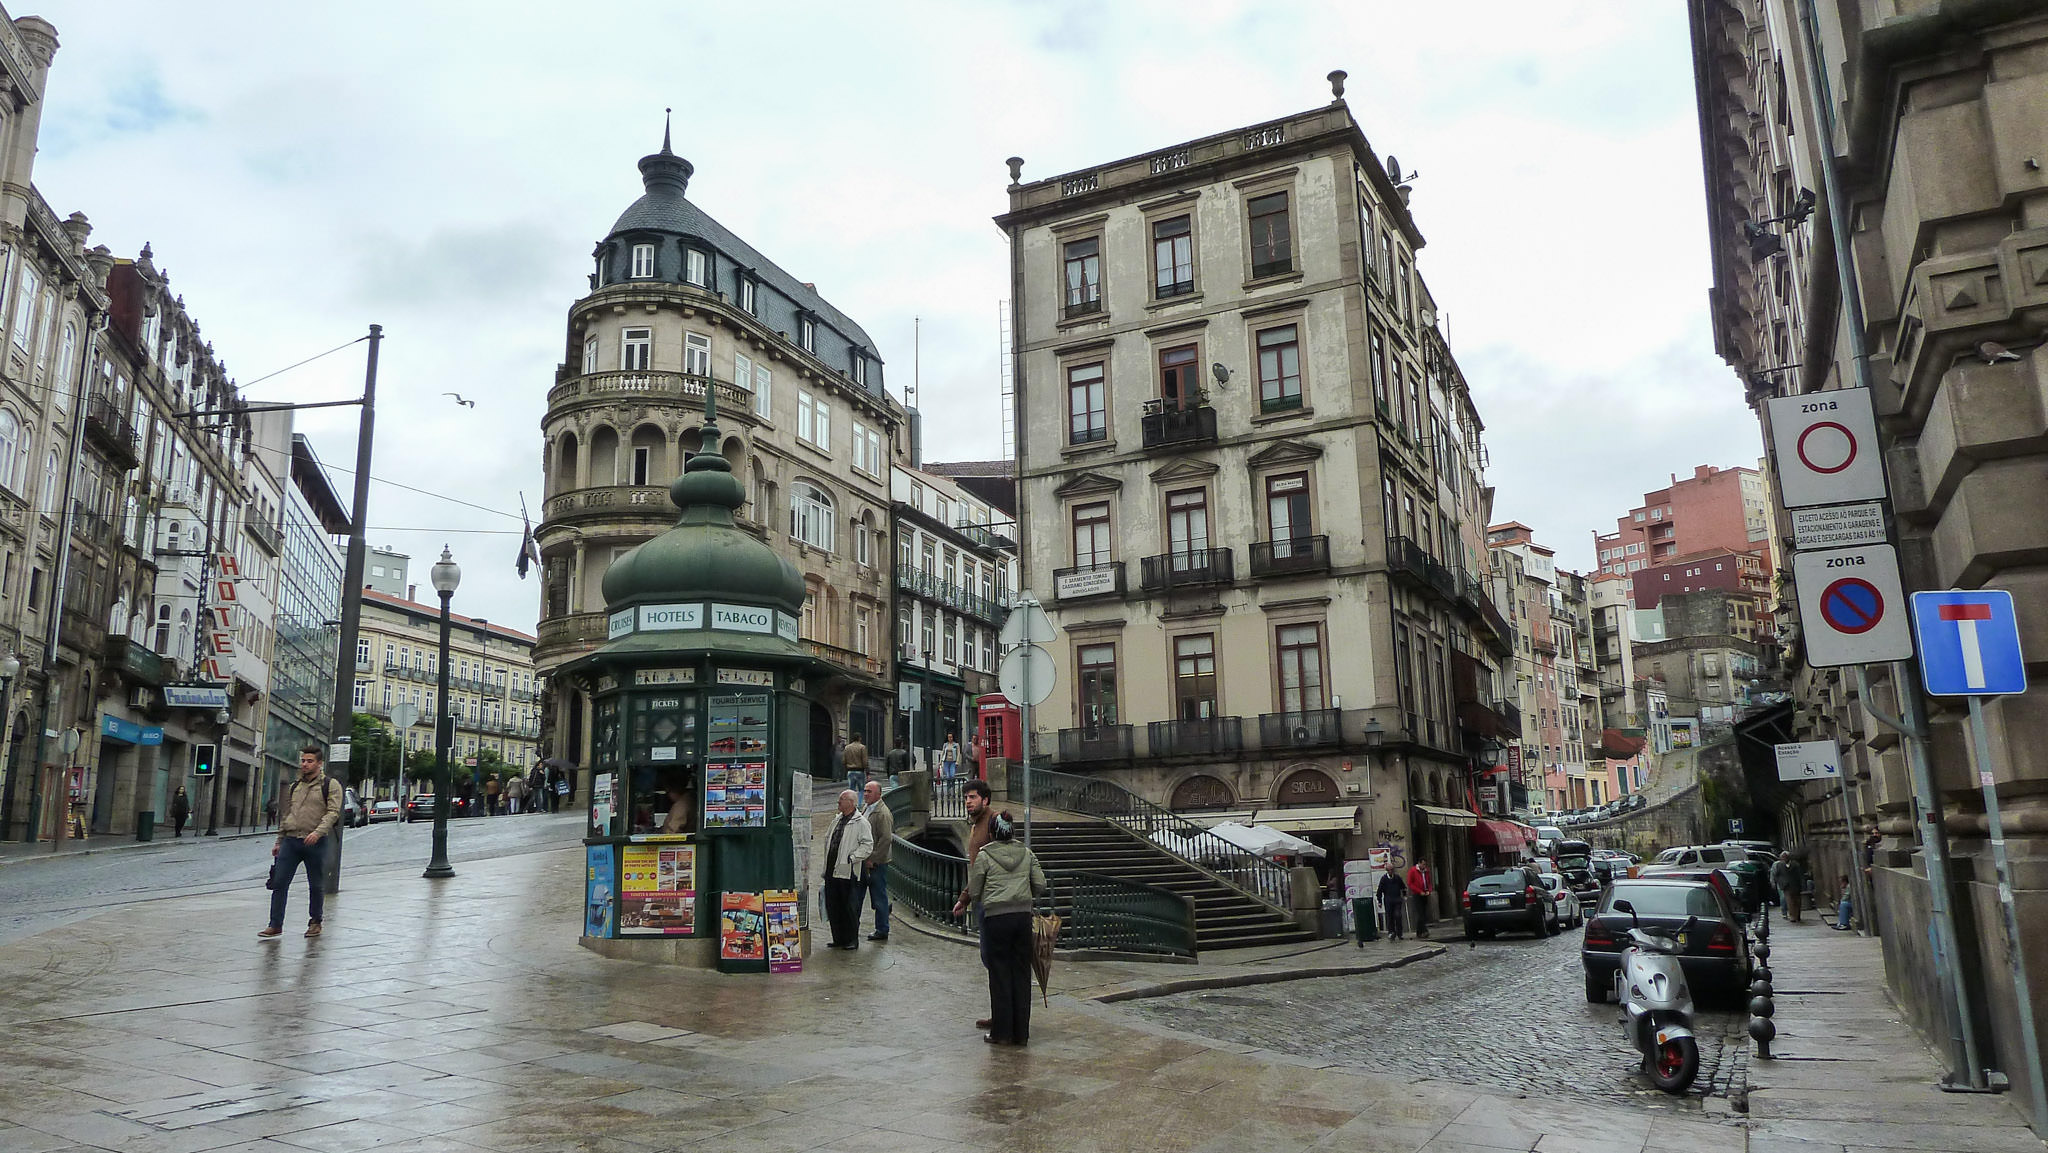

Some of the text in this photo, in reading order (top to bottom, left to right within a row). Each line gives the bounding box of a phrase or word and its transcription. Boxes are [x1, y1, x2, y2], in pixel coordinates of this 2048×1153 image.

[1802, 401, 1838, 413] zona
[1798, 508, 1877, 523] EXCETO ACESSO AO PARQUE DE
[1798, 522, 1842, 533] ESTACIONAMENTO
[1848, 520, 1876, 529] GARAGENS
[1876, 519, 1880, 527] E
[1796, 535, 1817, 544] CARGAS
[1822, 532, 1853, 542] DESCARGAS
[1853, 531, 1864, 540] DAS
[1826, 556, 1865, 568] zona
[210, 556, 239, 679] HOTEL
[647, 610, 695, 623] HOTELS
[716, 610, 768, 626] TABACO
[611, 615, 632, 632] CRUISES
[778, 618, 796, 636] REVISTAS
[652, 699, 679, 710] TICKETS
[712, 696, 766, 705] TOURIST SERVICE
[1291, 781, 1326, 794] SICAL
[1732, 820, 1738, 828] P
